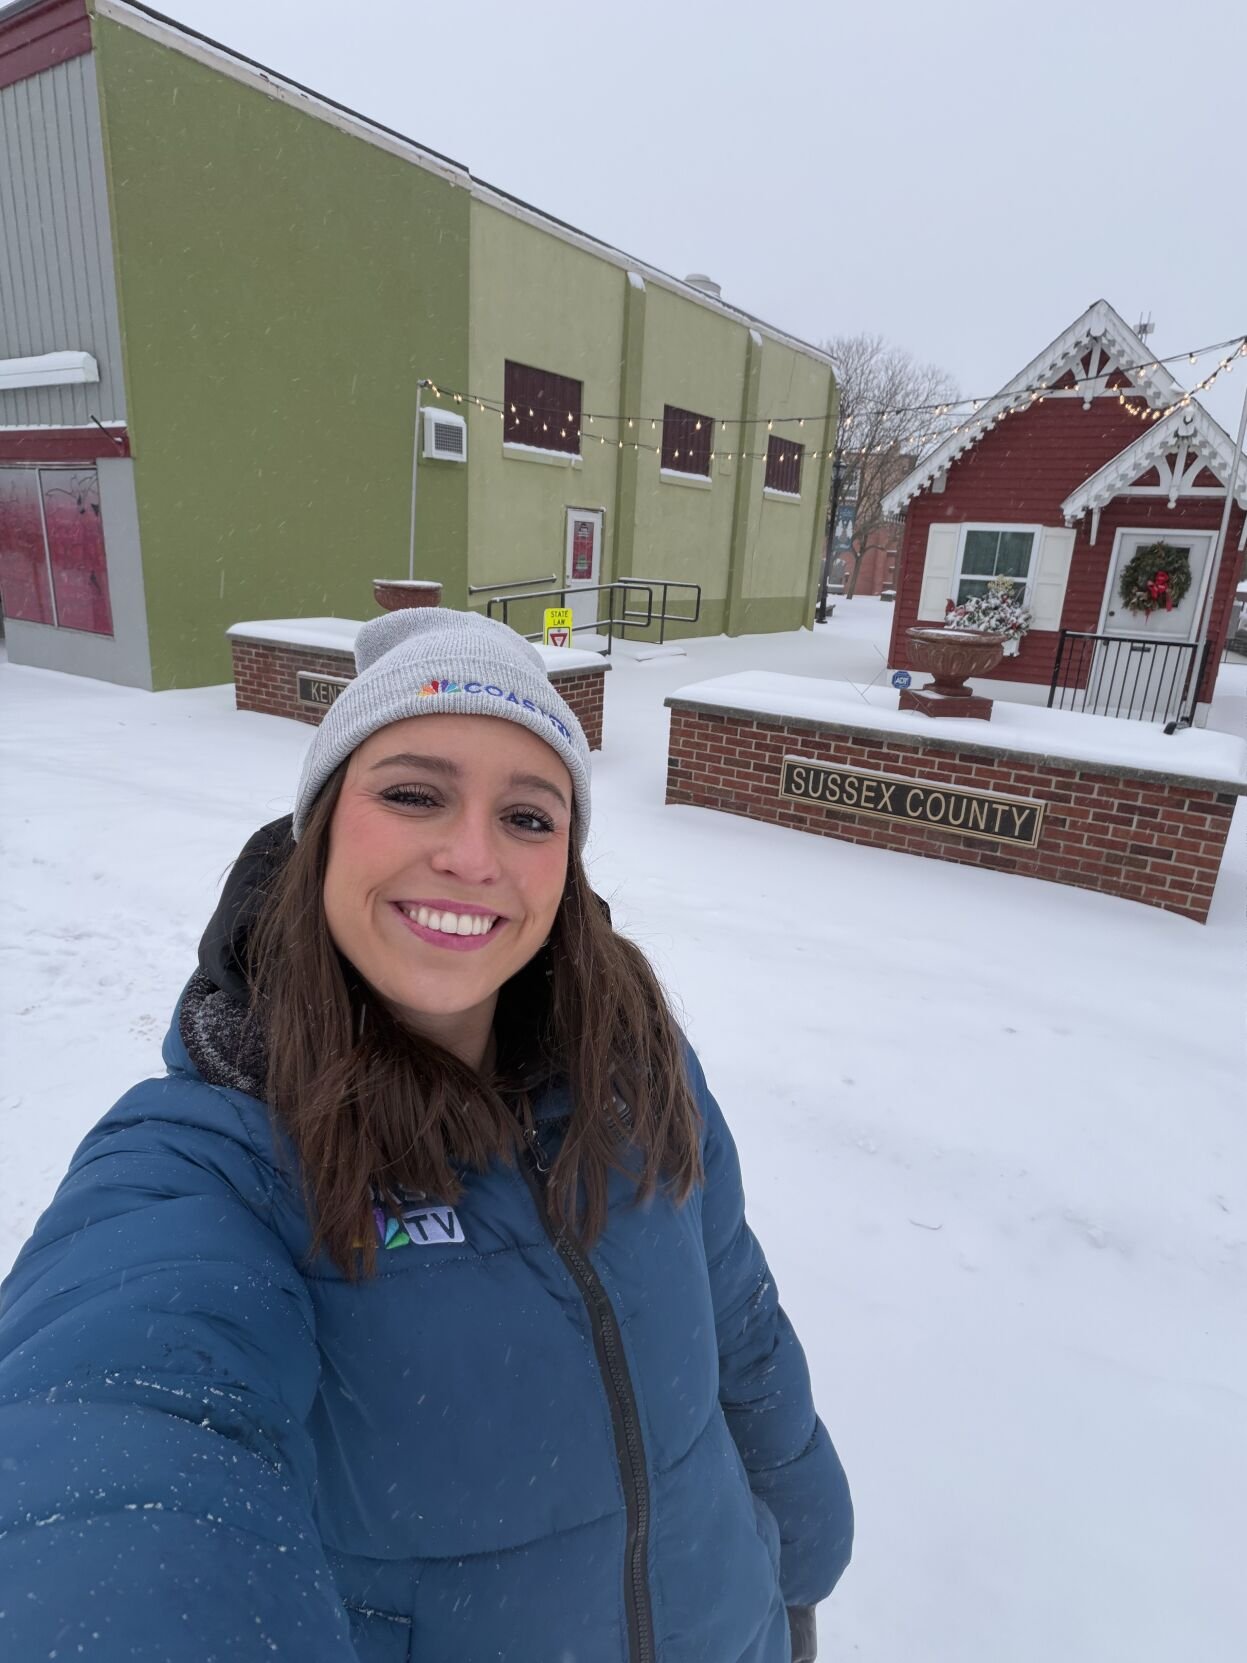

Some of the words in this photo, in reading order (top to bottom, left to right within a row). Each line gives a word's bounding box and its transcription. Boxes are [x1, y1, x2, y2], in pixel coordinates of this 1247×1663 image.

[551, 610, 568, 618] STATE
[791, 767, 896, 812] SUSSEX
[906, 788, 1030, 836] COUNTY
[402, 1211, 455, 1241] TV
